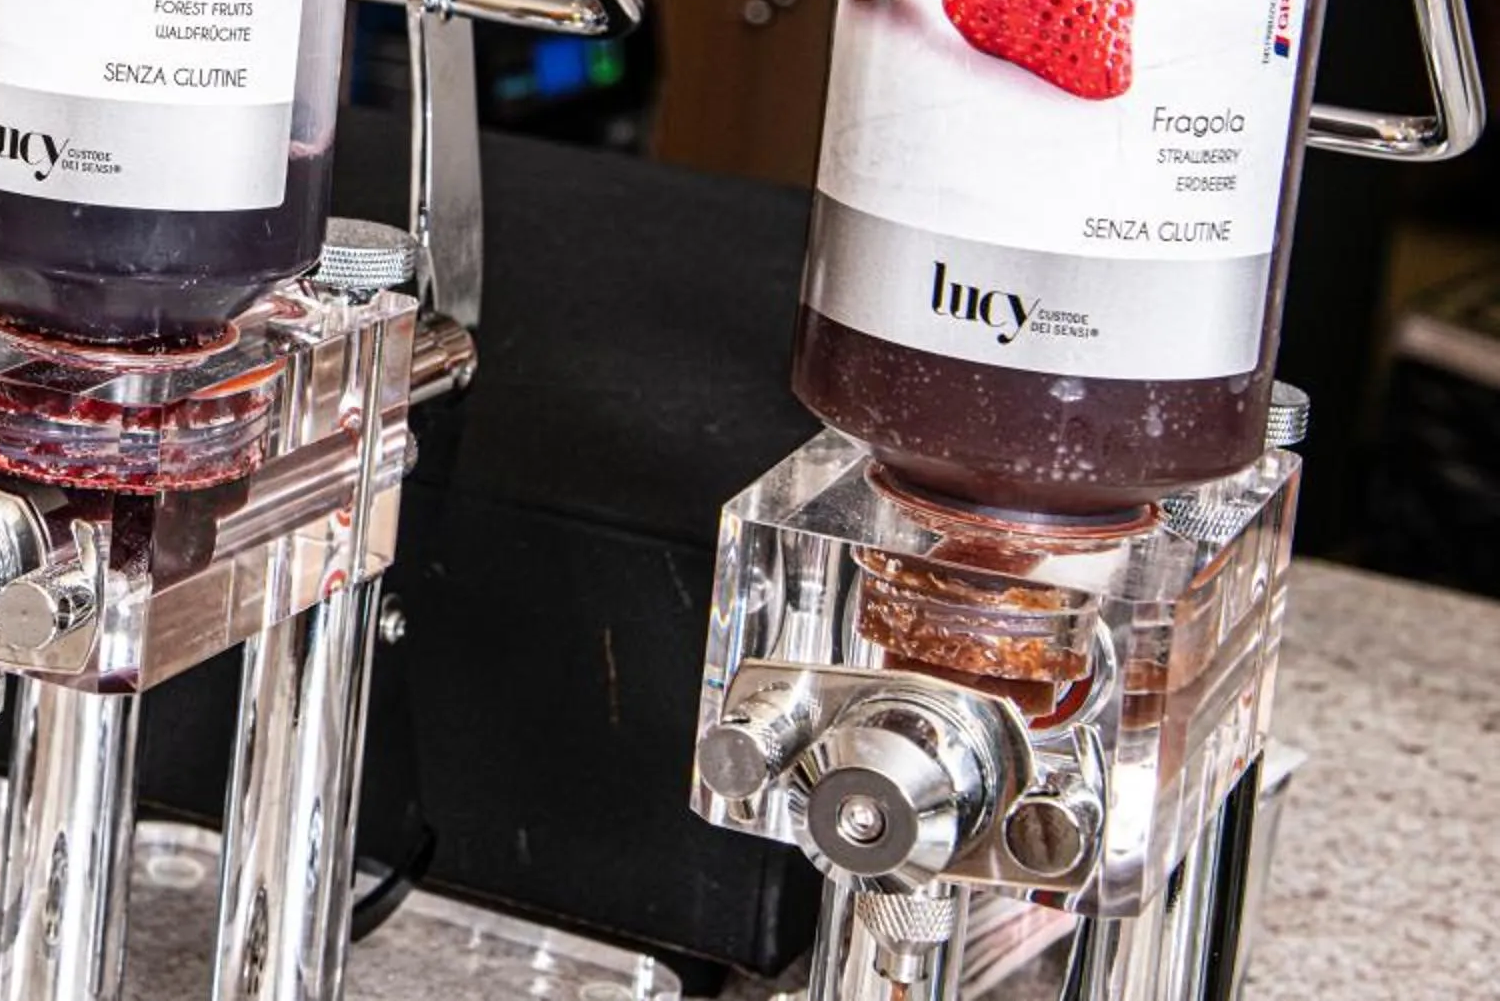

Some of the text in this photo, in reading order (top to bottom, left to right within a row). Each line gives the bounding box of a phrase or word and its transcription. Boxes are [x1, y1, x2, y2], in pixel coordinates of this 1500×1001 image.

[154, 0, 253, 16] FOREST FRUITS
[103, 62, 248, 88] SENZA GLUTINE
[1152, 106, 1246, 138] Fragola
[67, 149, 113, 162] CUSTODE
[61, 159, 78, 172] DEI
[1083, 217, 1233, 242] SENZA GLUTINE
[931, 260, 1041, 345] lucy
[1037, 309, 1089, 325] CUSTODE
[1030, 322, 1051, 335] DEI
